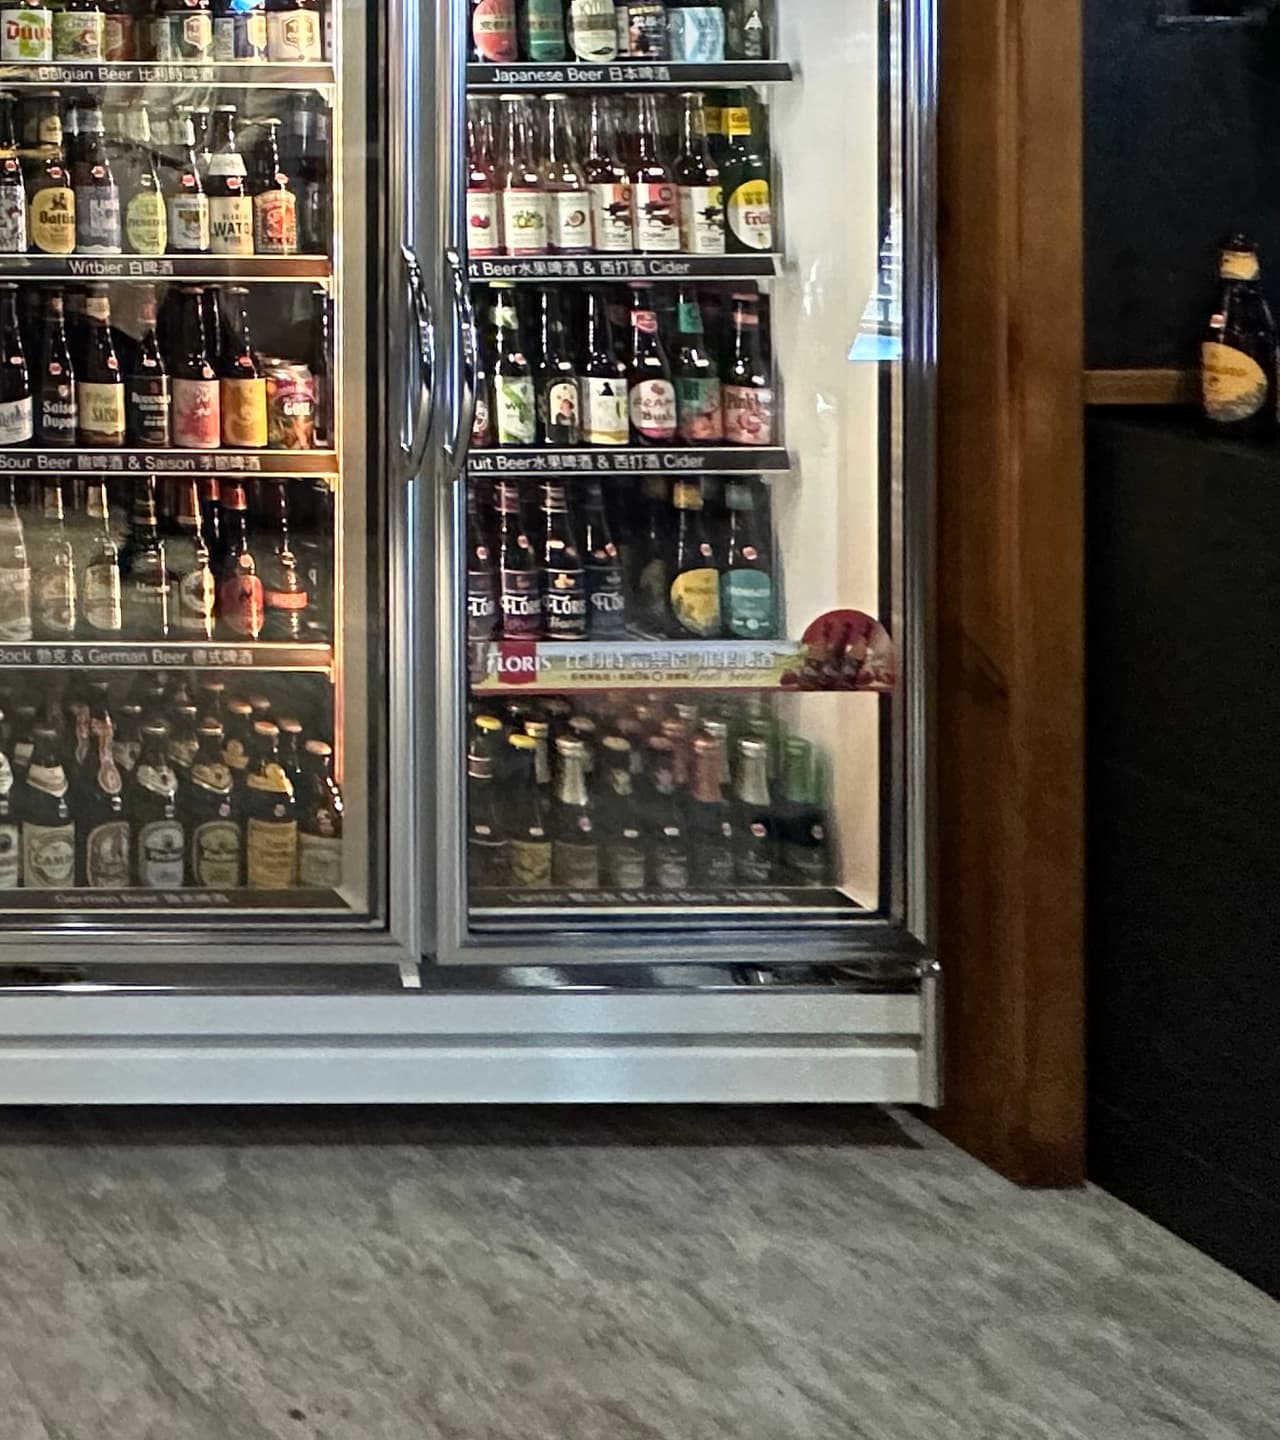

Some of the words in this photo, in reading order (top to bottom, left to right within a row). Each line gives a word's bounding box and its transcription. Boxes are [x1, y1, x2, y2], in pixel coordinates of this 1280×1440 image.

[38, 66, 93, 83] Belgian
[98, 66, 133, 81] Beer
[492, 68, 563, 84] Japanese
[566, 67, 604, 81] Beer
[608, 66, 671, 81] 日本啤酒
[68, 260, 124, 274] Witbier
[128, 260, 174, 274] 白啤酒
[583, 261, 595, 275] &
[649, 261, 691, 275] Cider
[37, 455, 72, 469] Beer
[128, 455, 140, 470] &
[145, 455, 195, 470] Saison
[596, 455, 609, 469] &
[663, 455, 704, 469] Cider
[71, 650, 83, 663] &
[87, 649, 148, 664] German
[152, 649, 187, 664] Beer
